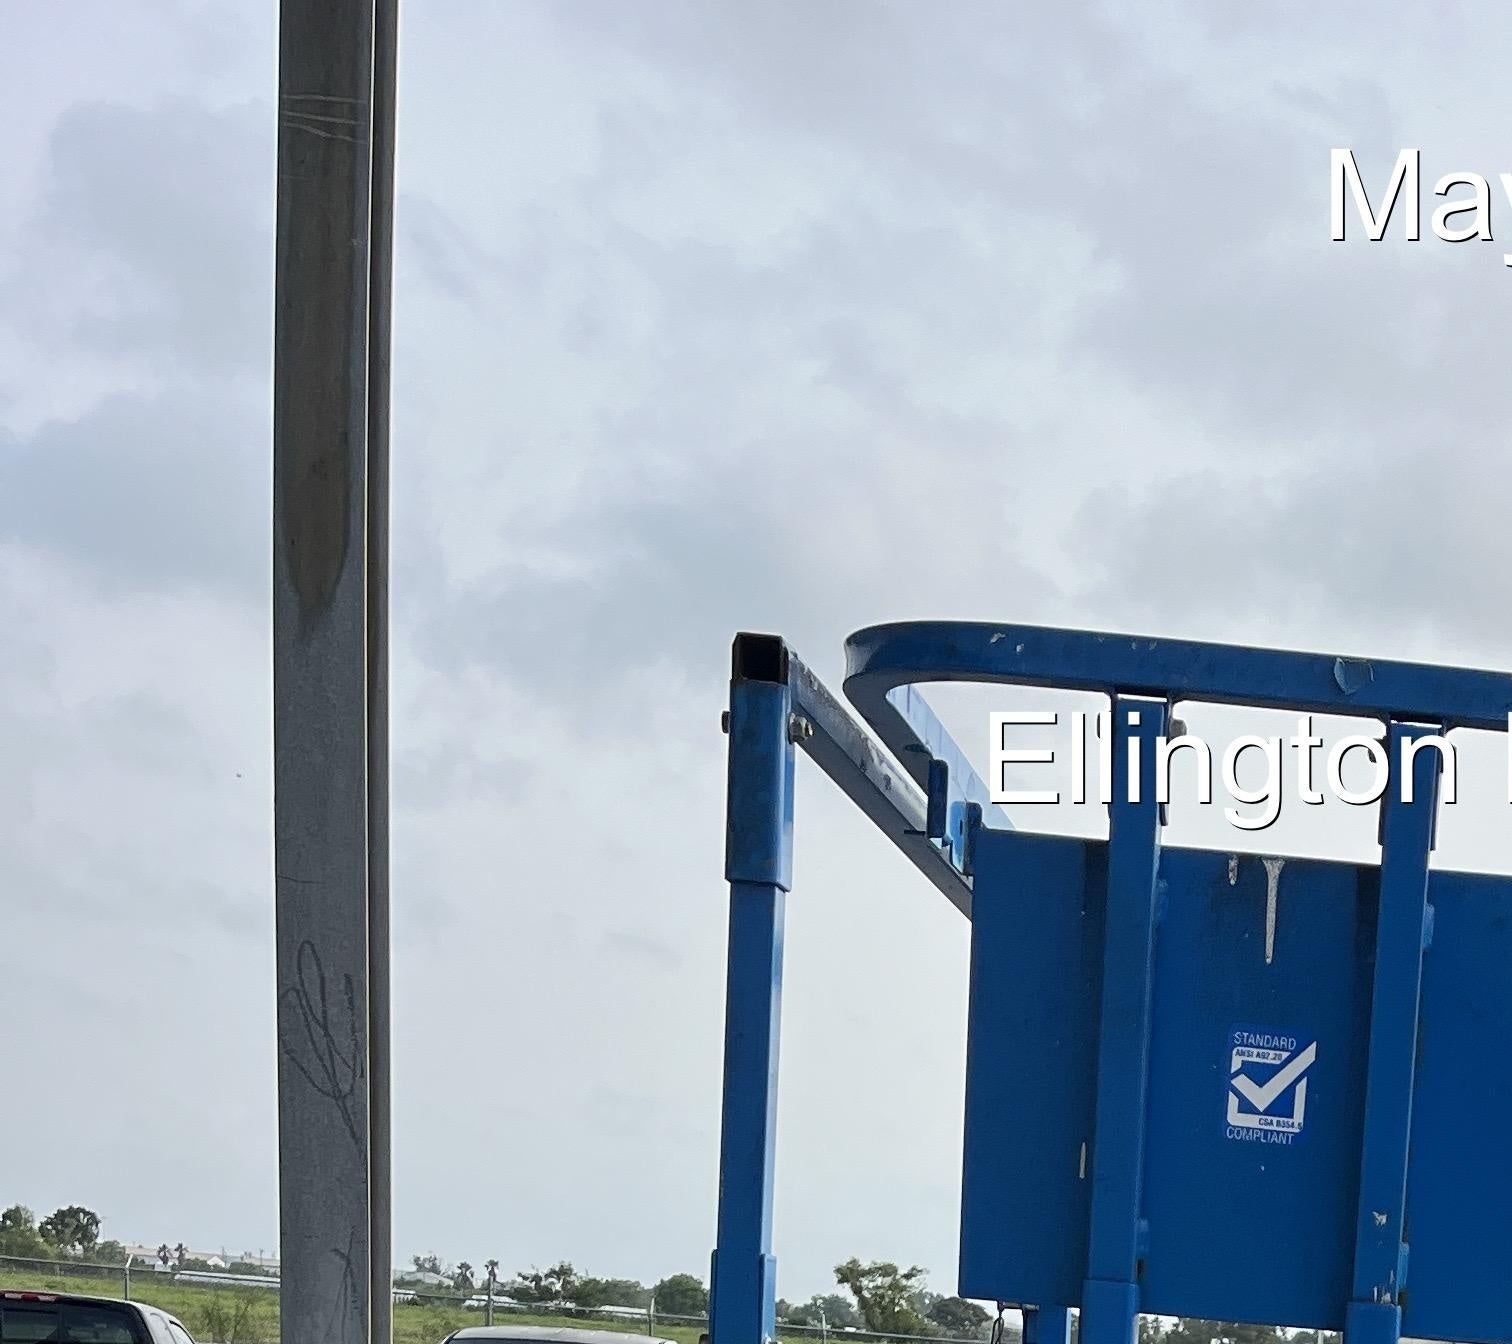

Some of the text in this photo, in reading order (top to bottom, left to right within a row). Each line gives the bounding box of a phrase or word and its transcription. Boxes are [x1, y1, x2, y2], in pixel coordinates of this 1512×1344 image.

[1233, 1031, 1297, 1050] STANDARD
[1259, 1117, 1274, 1127] CSA
[1226, 1126, 1294, 1145] COMPLIANT
